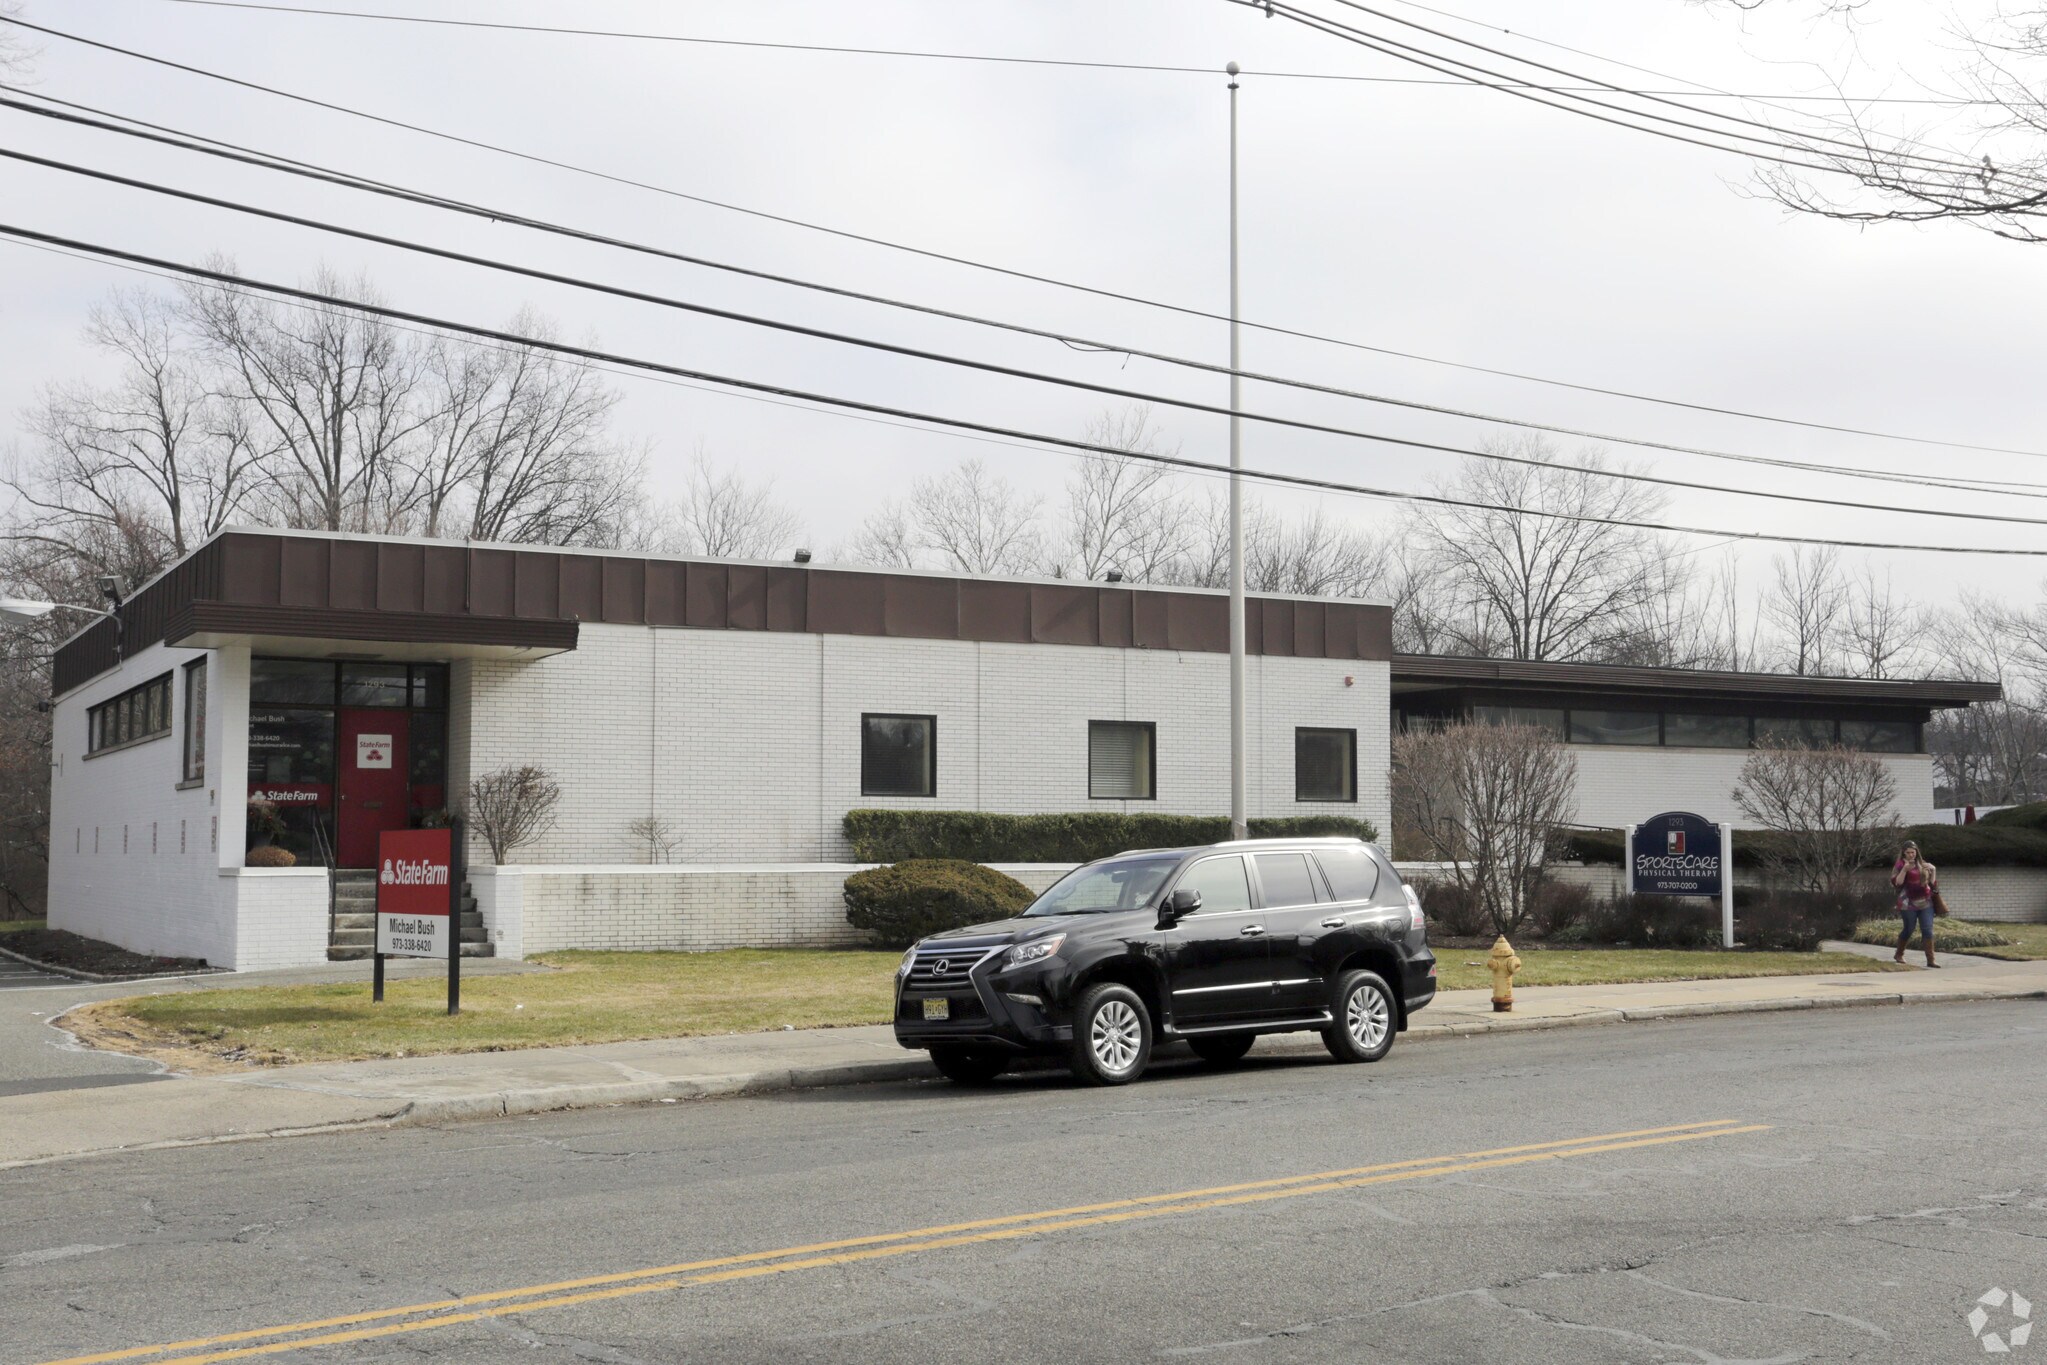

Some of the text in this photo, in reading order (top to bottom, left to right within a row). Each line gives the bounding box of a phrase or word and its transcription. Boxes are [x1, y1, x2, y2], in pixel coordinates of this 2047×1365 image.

[267, 790, 318, 801] StateFarm
[1668, 818, 1685, 826] 1293
[395, 859, 448, 885] StateFarm
[1679, 869, 1717, 877] THERAPY
[1657, 881, 1698, 889] 973-707-0200
[389, 918, 435, 935] Michael Bush
[392, 938, 432, 952] 973-338-6420
